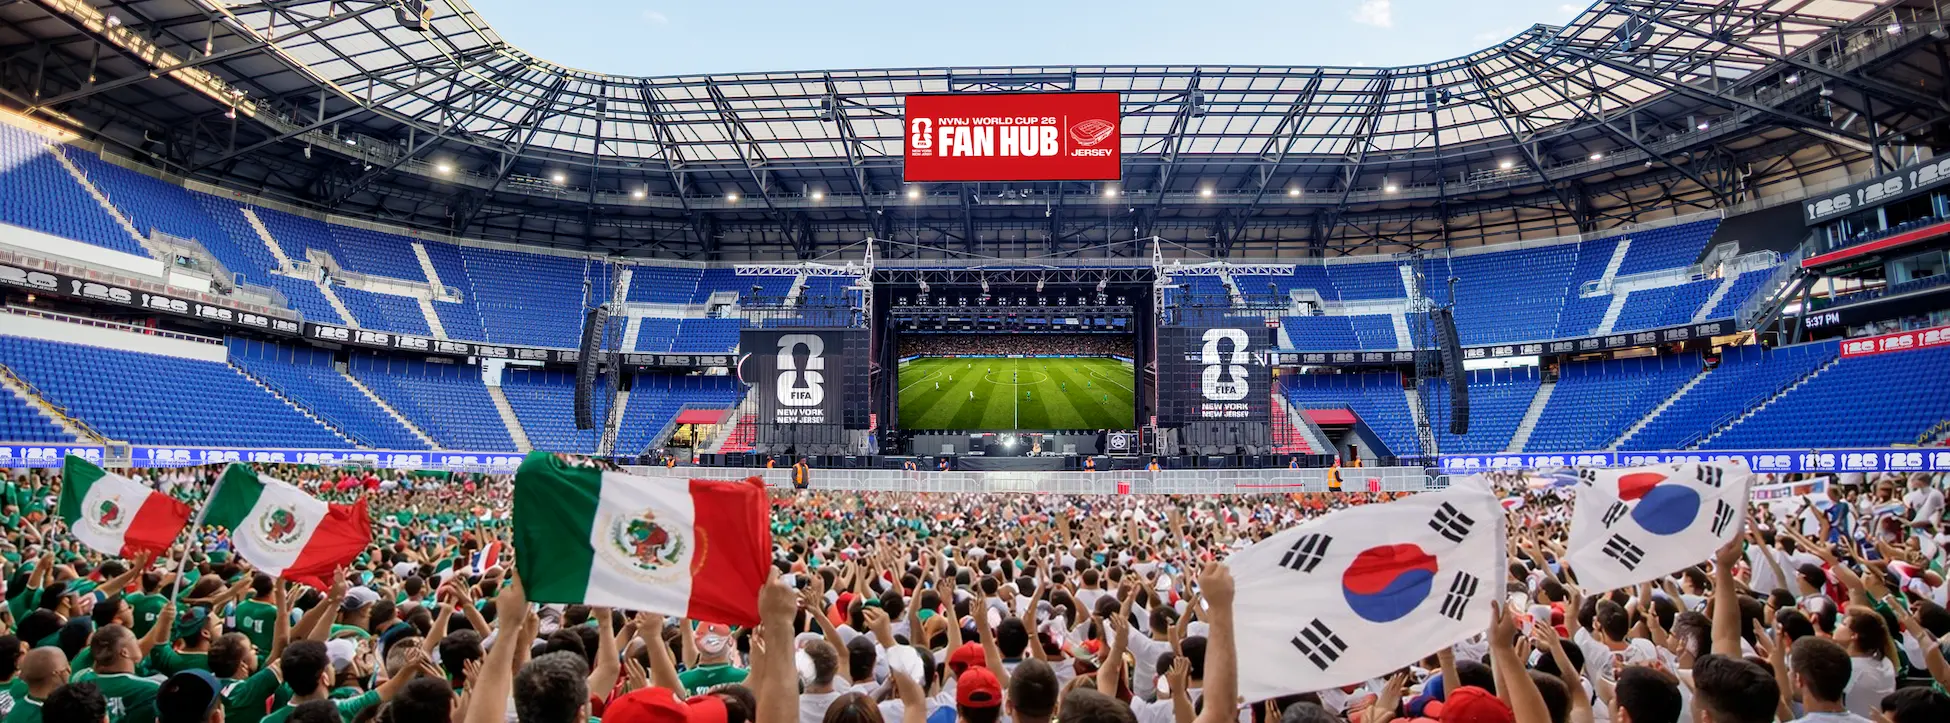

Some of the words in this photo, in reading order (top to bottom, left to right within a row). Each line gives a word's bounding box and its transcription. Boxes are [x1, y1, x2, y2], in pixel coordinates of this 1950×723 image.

[938, 117, 969, 125] NYNJ
[972, 117, 1012, 125] WORLD
[1015, 117, 1038, 125] CUP
[1041, 117, 1056, 125] 26
[938, 126, 994, 157] FAN
[1000, 126, 1058, 156] HUB
[1071, 148, 1112, 156] JERSEY
[1806, 314, 1824, 328] 5:37
[1826, 312, 1839, 324] PM
